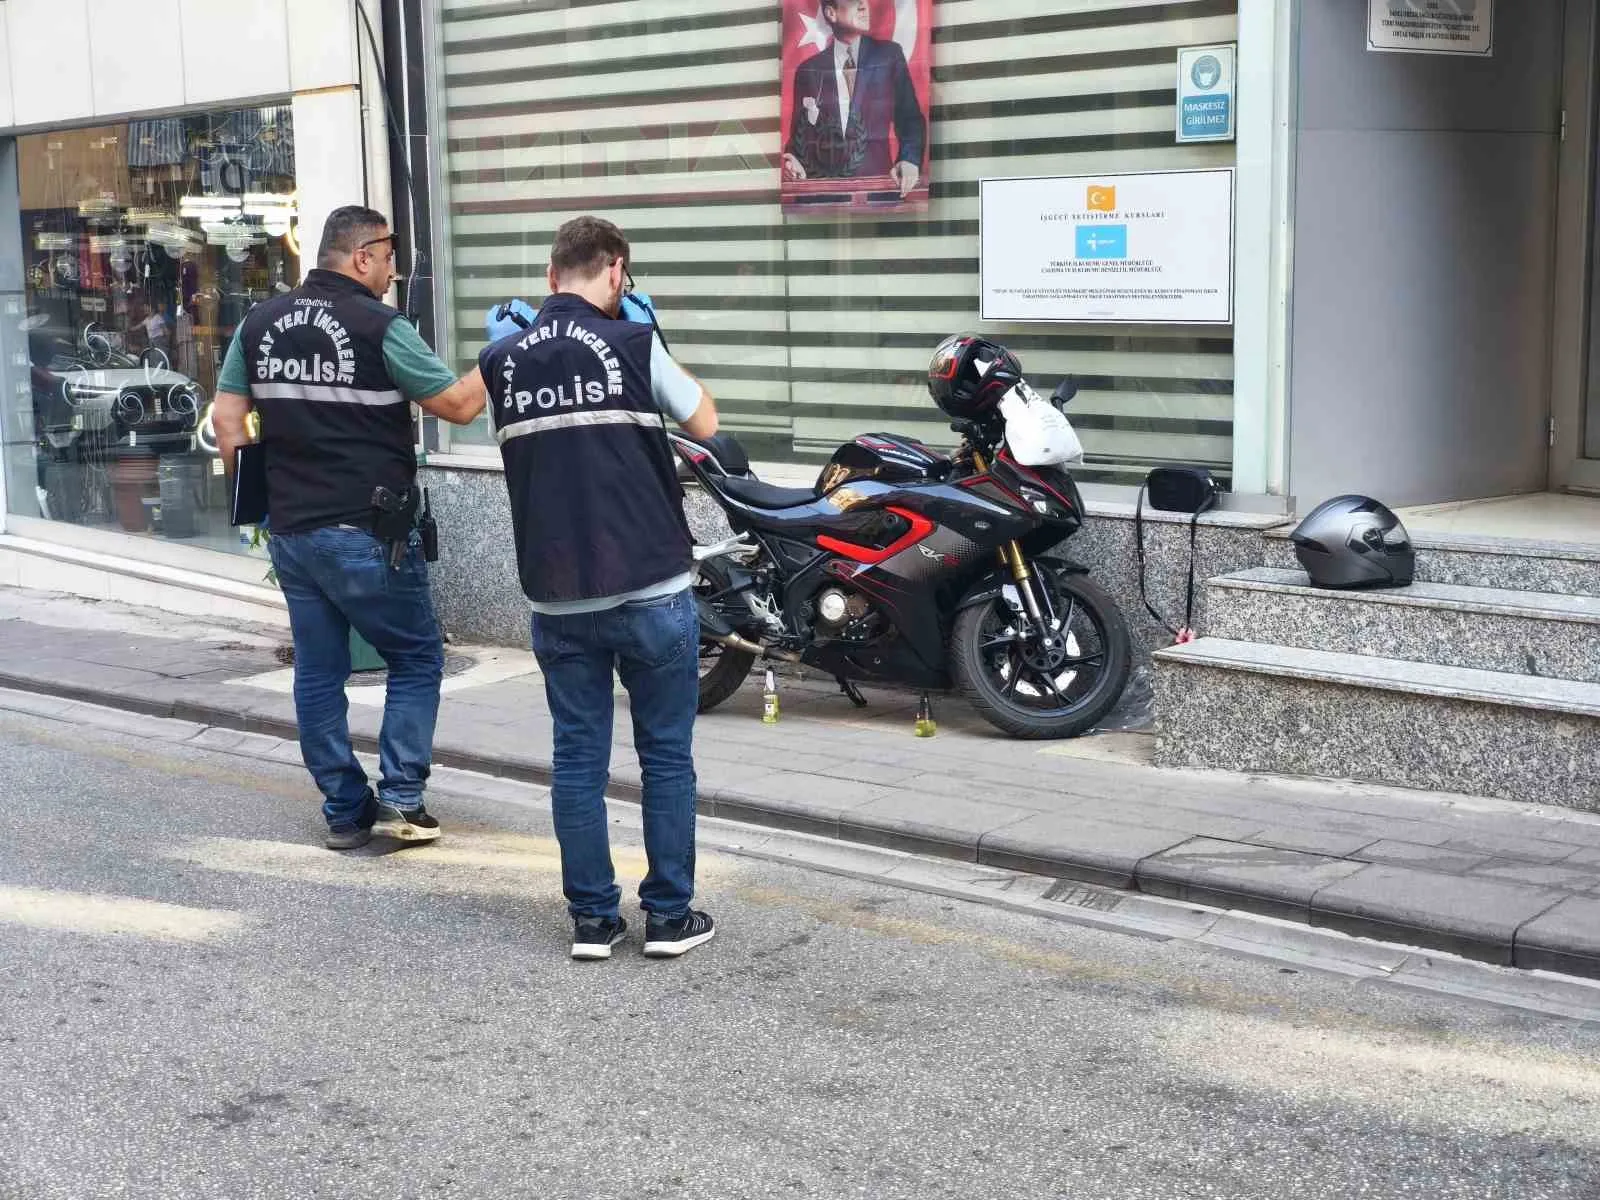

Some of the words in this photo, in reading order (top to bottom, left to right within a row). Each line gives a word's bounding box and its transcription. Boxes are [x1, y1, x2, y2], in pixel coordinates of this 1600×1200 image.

[257, 329, 275, 380] OLAY
[274, 306, 311, 334] YERİ
[313, 307, 356, 385] İNCELEME
[268, 353, 335, 383] POLİS
[503, 353, 516, 408] OLAY
[516, 319, 558, 351] YERİ
[565, 320, 623, 396] İNCELEME
[514, 375, 605, 414] POLİS
